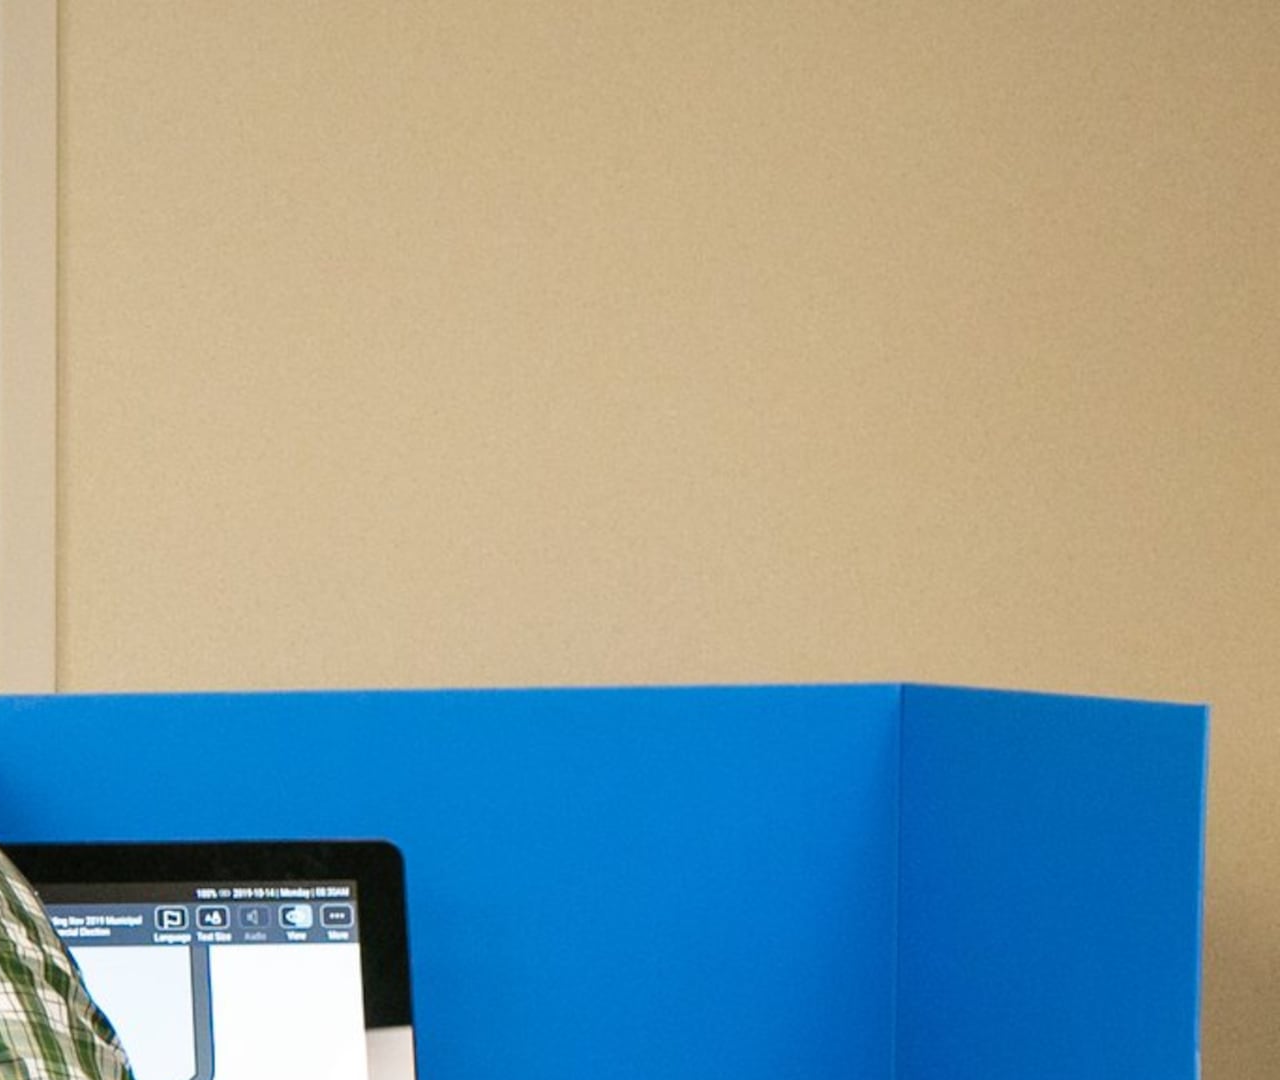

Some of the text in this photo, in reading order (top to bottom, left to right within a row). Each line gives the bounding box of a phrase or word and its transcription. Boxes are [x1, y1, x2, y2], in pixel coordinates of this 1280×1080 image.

[280, 887, 310, 900] Monday
[153, 932, 191, 944] Language
[244, 931, 266, 942] Audio
